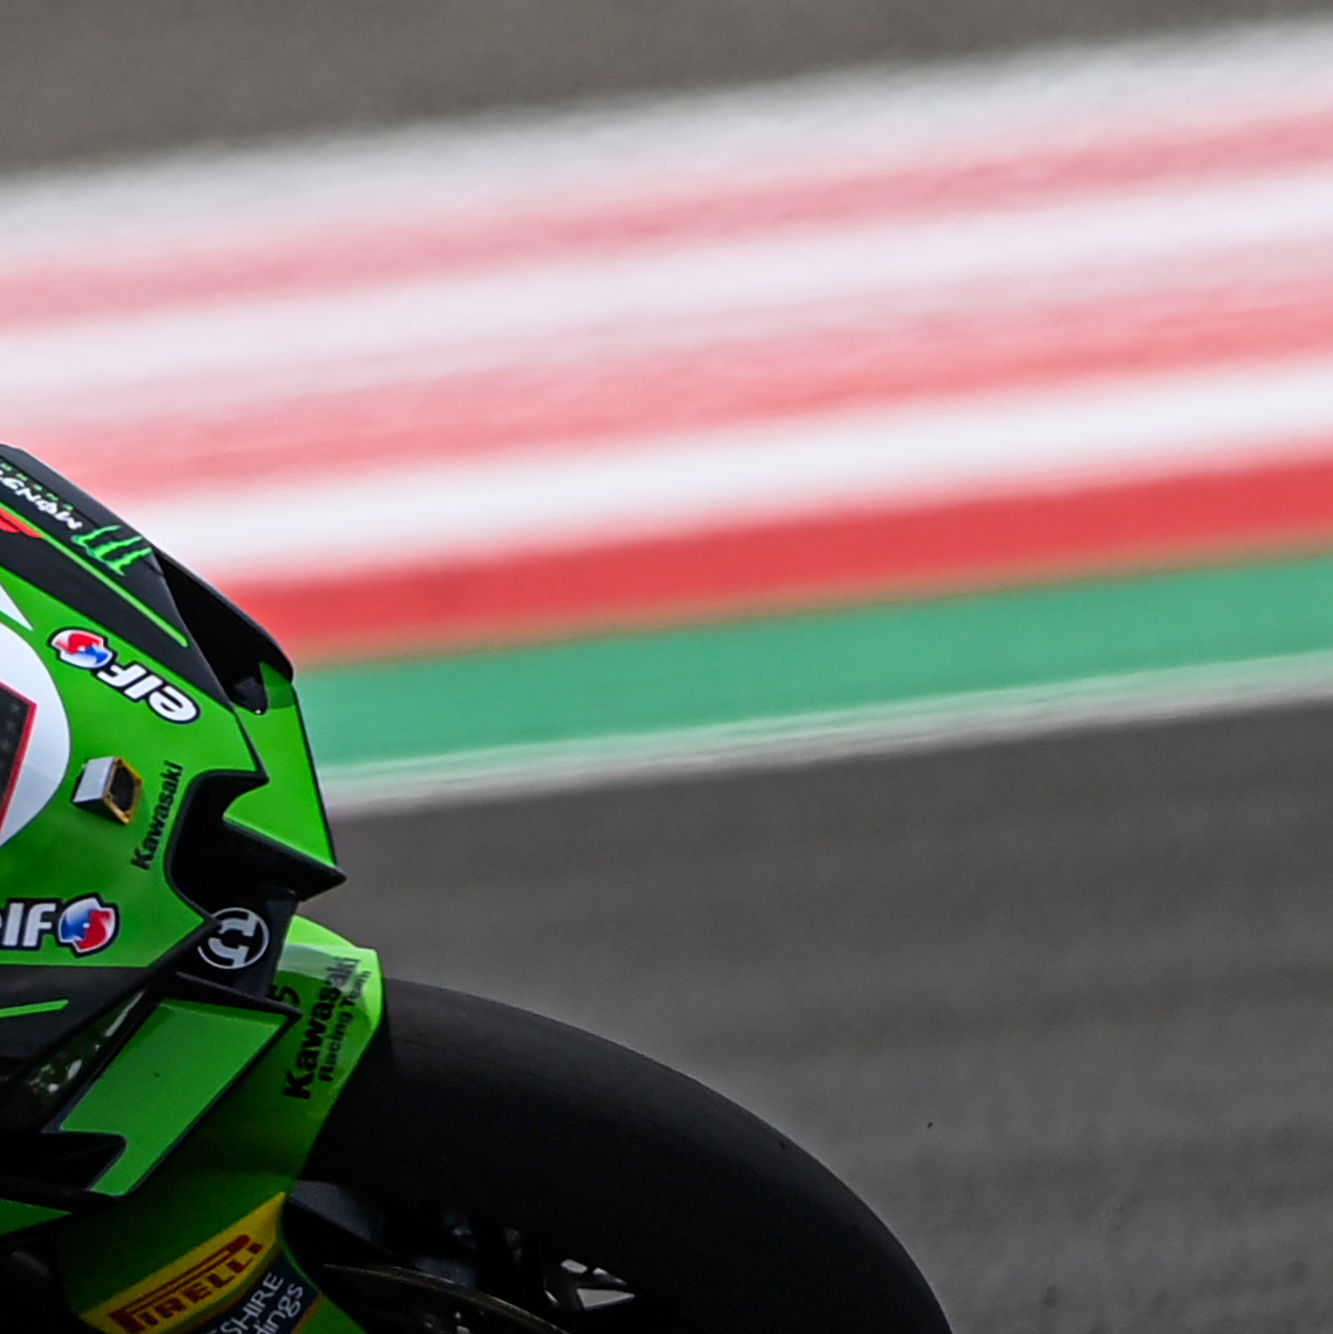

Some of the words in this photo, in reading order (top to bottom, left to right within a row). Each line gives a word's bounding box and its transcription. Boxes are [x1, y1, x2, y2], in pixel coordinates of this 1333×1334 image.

[96, 662, 199, 725] elf
[130, 760, 184, 871] Kawasaki
[284, 956, 362, 1099] Kawasaki
[109, 1234, 263, 1334] PIRELLI
